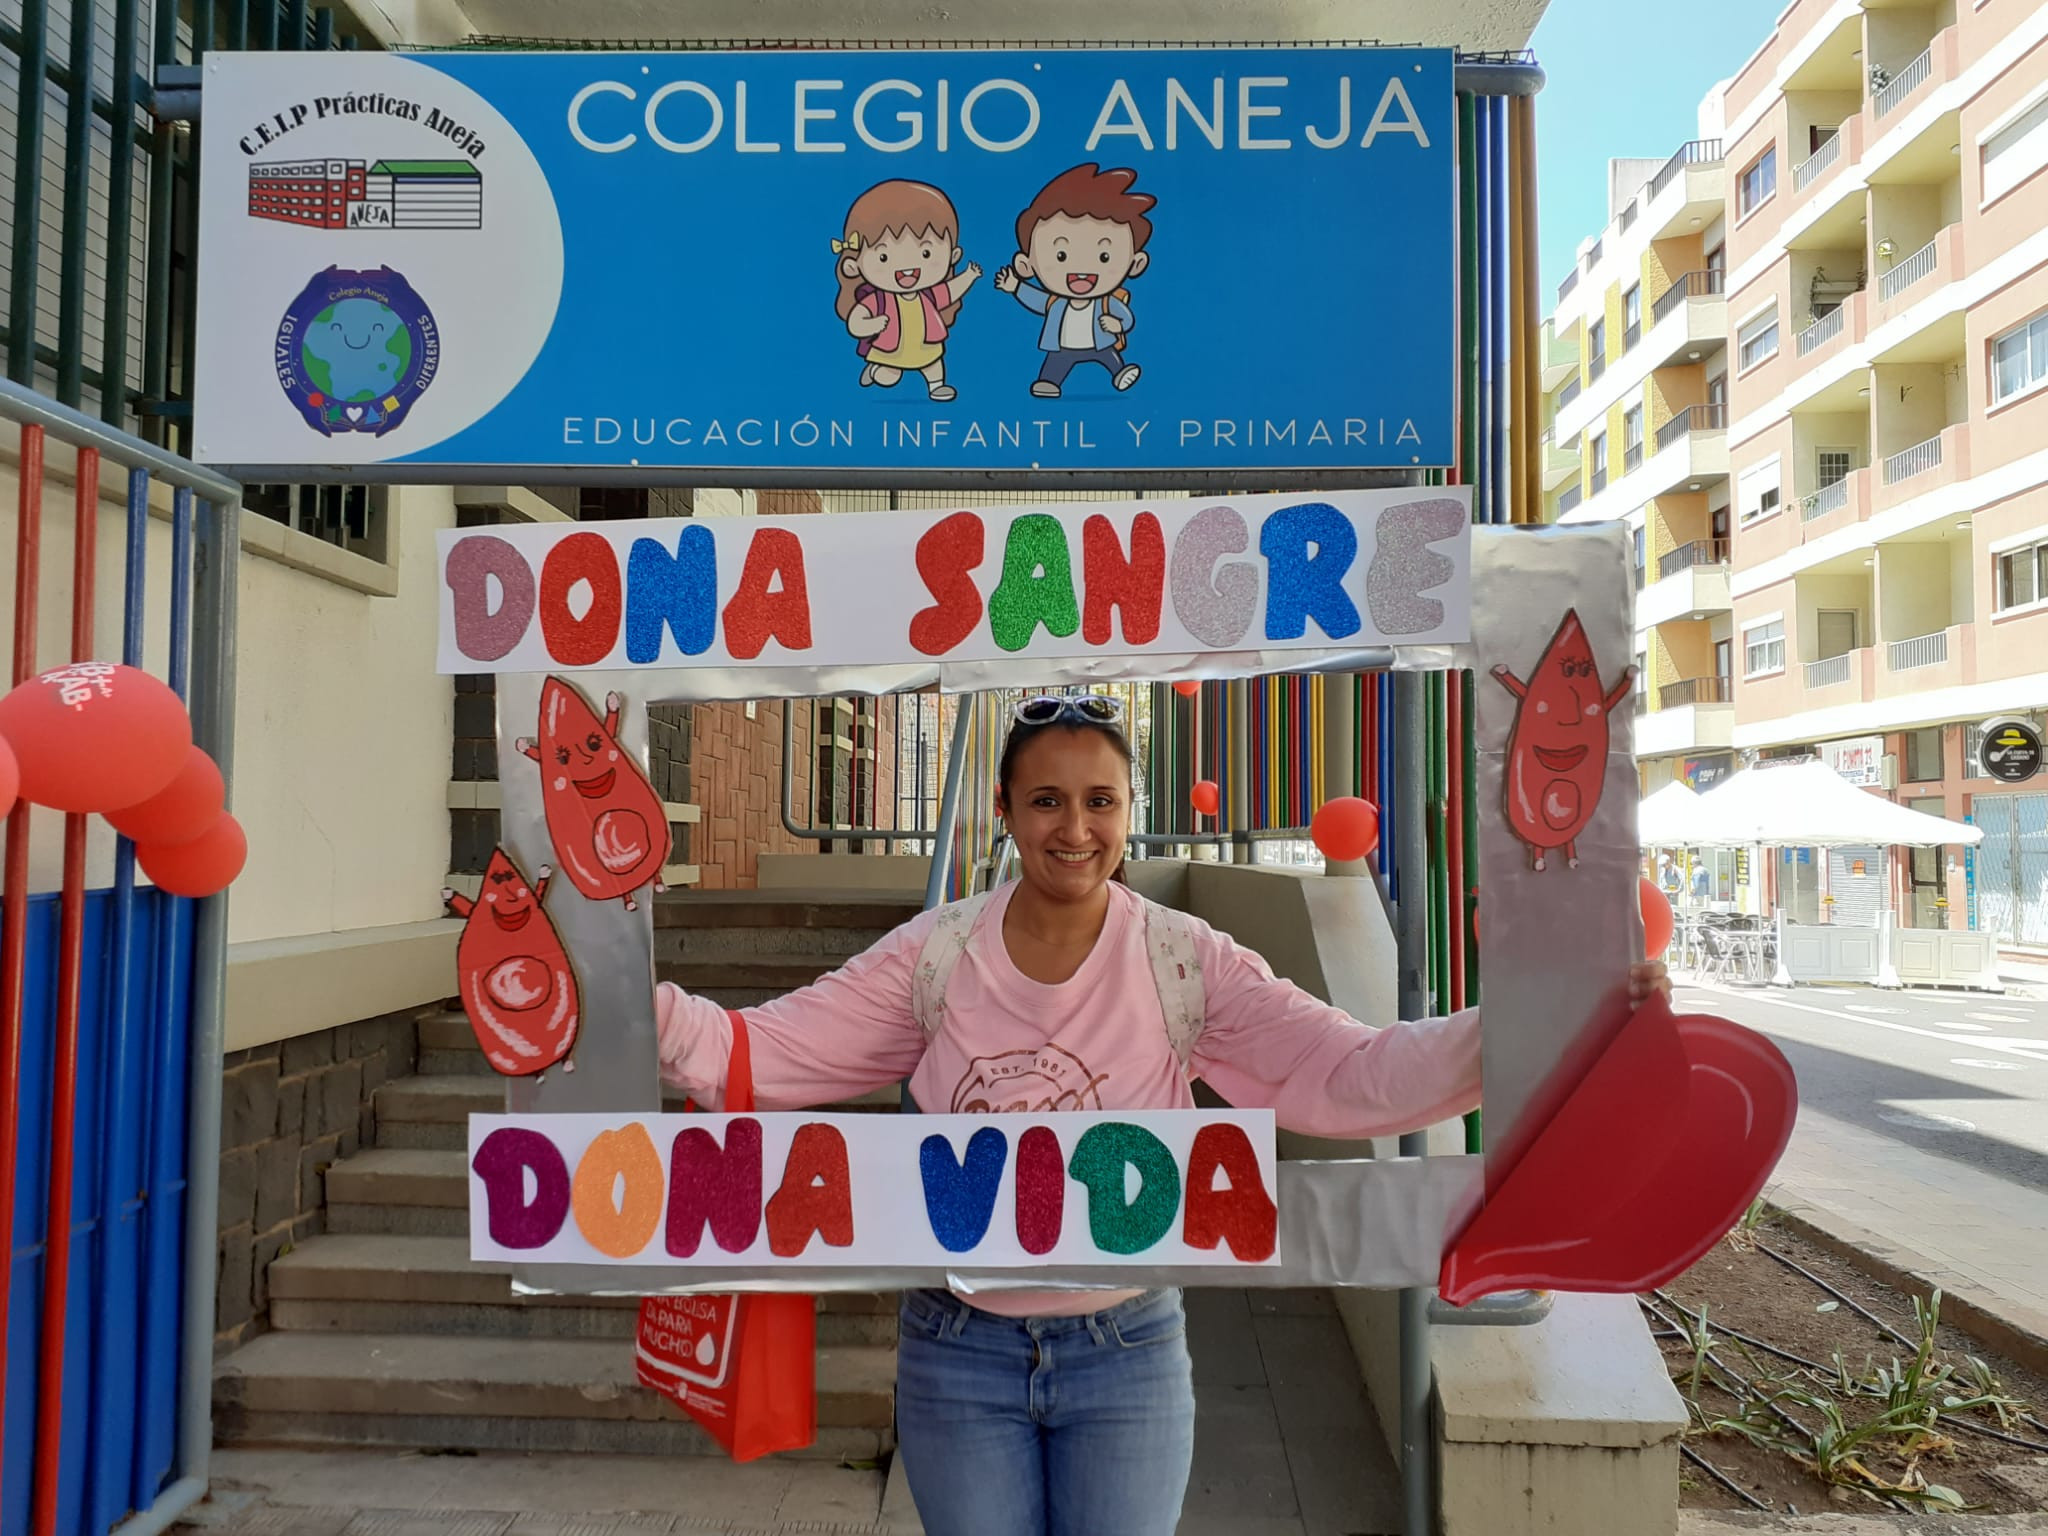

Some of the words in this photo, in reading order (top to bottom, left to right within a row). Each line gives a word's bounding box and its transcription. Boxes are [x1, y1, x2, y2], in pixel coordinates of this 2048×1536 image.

[239, 104, 308, 156] C.E.I.P
[313, 91, 421, 122] Prácticas
[423, 106, 486, 159] Aneja
[567, 79, 1042, 154] COLEGIO
[1086, 76, 1432, 152] ANEJA
[328, 286, 362, 302] Colegio
[364, 286, 389, 303] Aneja
[276, 314, 298, 389] IGUALES
[415, 314, 438, 390] DIFERENTES
[563, 413, 854, 449] EDUCACIÓN
[882, 420, 1097, 449] INFANTIL
[1127, 420, 1150, 447] Y
[1180, 418, 1422, 447] PRIMARIA
[445, 524, 813, 665] DONA
[909, 500, 1465, 657] SANGRE
[990, 1065, 1025, 1076] EST.
[1032, 1058, 1067, 1078] 1981
[472, 1117, 855, 1259] DONA
[918, 1121, 1279, 1263] VIDA
[658, 1309, 694, 1337] PARA
[673, 1296, 717, 1324] BOLSA
[643, 1321, 694, 1359] MUCHO
